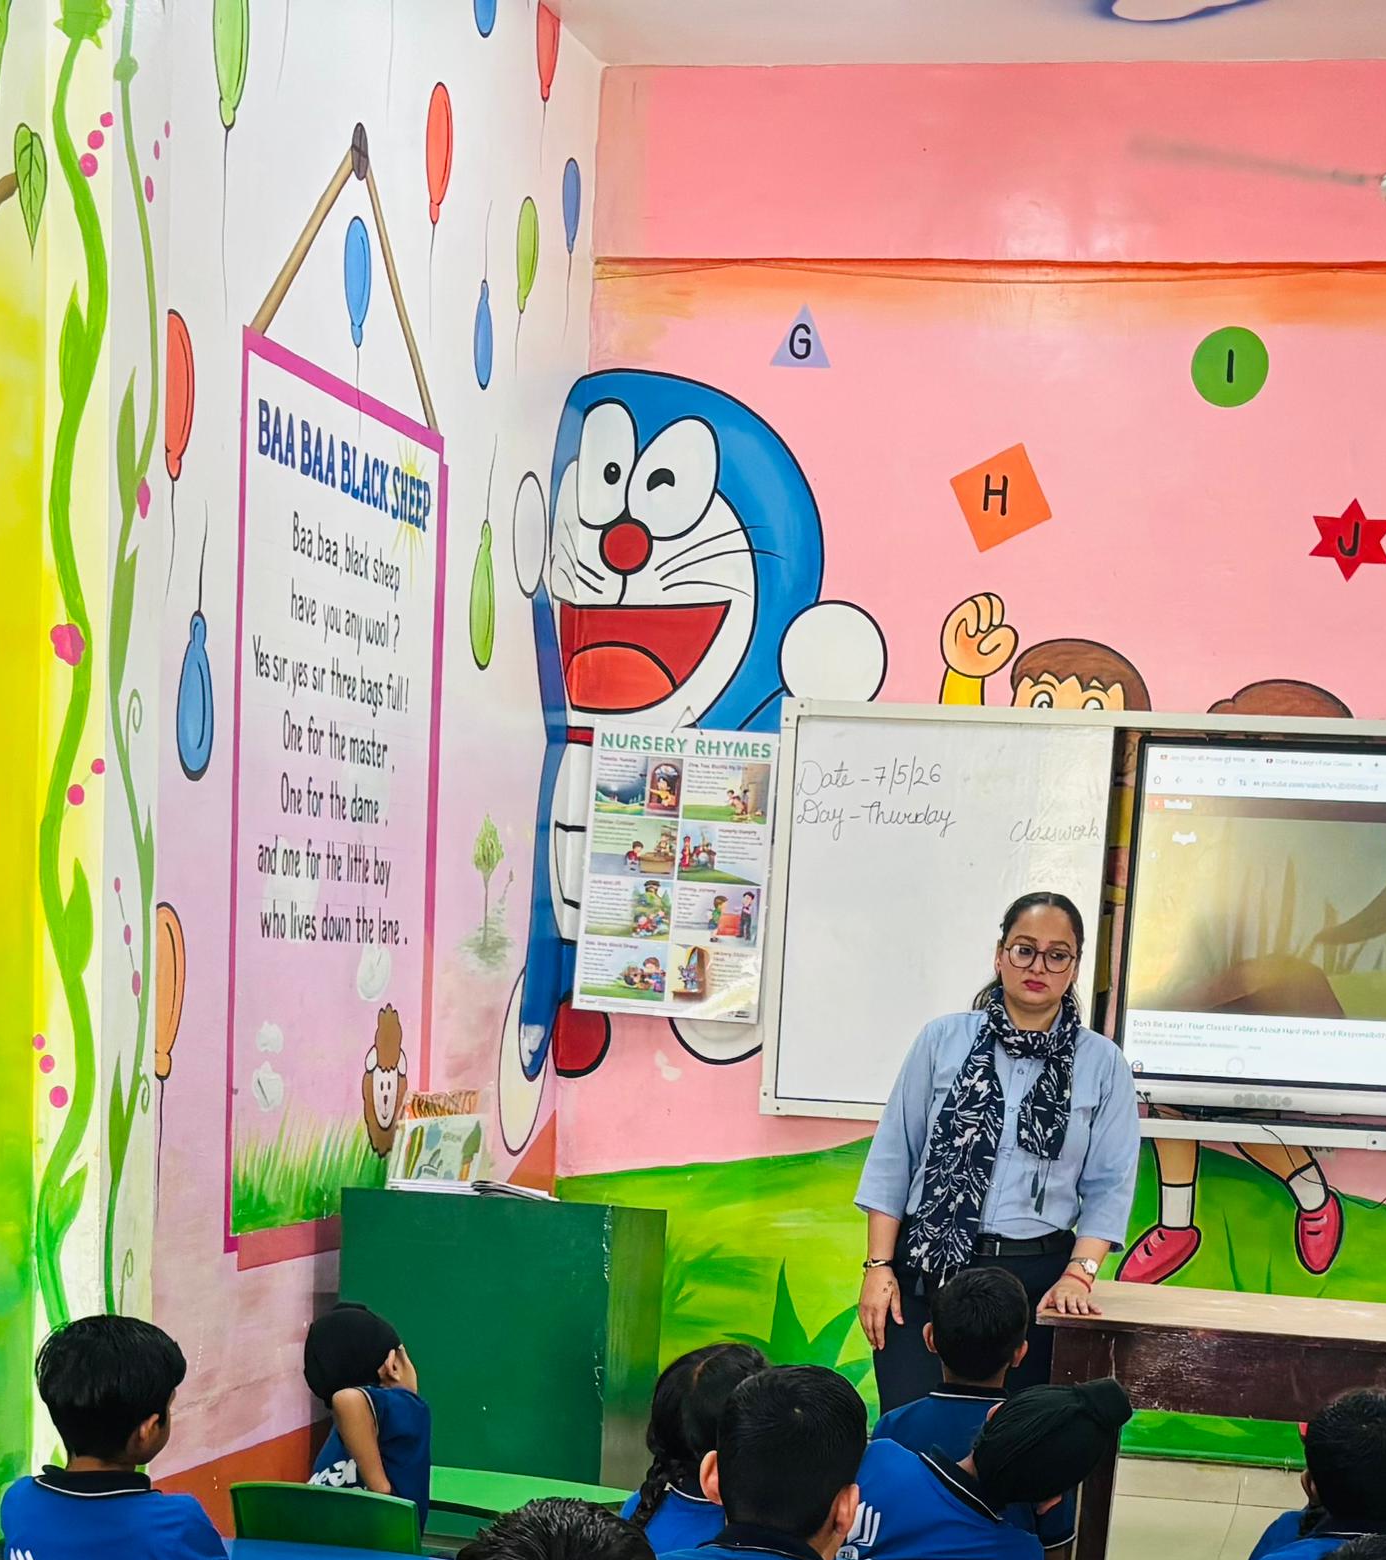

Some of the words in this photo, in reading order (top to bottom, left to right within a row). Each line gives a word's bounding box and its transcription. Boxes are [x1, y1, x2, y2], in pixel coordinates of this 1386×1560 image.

[789, 323, 811, 360] G
[258, 398, 296, 469] BAA
[300, 419, 336, 489] BAA
[341, 441, 389, 513] BLACK
[391, 466, 431, 532] SHEEP
[983, 474, 1008, 516] H
[1338, 521, 1359, 556] J
[345, 532, 369, 580] black
[373, 547, 400, 602] sheep
[290, 577, 316, 626] have
[323, 603, 341, 644] you
[345, 609, 362, 656] any
[253, 634, 270, 678] Yes
[312, 665, 326, 692] sir
[331, 657, 357, 701] three
[361, 665, 383, 717] bags
[283, 709, 303, 751] One
[307, 715, 324, 756] for
[329, 720, 346, 761] the
[601, 732, 687, 754] NURSERY
[695, 739, 771, 758] RHYMES
[281, 772, 302, 814] One
[307, 776, 324, 818] for
[330, 781, 346, 820] the
[796, 760, 854, 795] Date
[873, 756, 942, 795] 7/5/26
[797, 799, 845, 841] Day
[1010, 818, 1101, 842] Classwork
[258, 834, 278, 875] and
[282, 847, 300, 878] one
[306, 839, 321, 881] for
[326, 840, 342, 882] the
[346, 843, 369, 884] little
[374, 846, 391, 898] boy
[261, 899, 286, 939] who
[290, 901, 317, 941] lives
[321, 904, 351, 942] down
[356, 905, 373, 945] the
